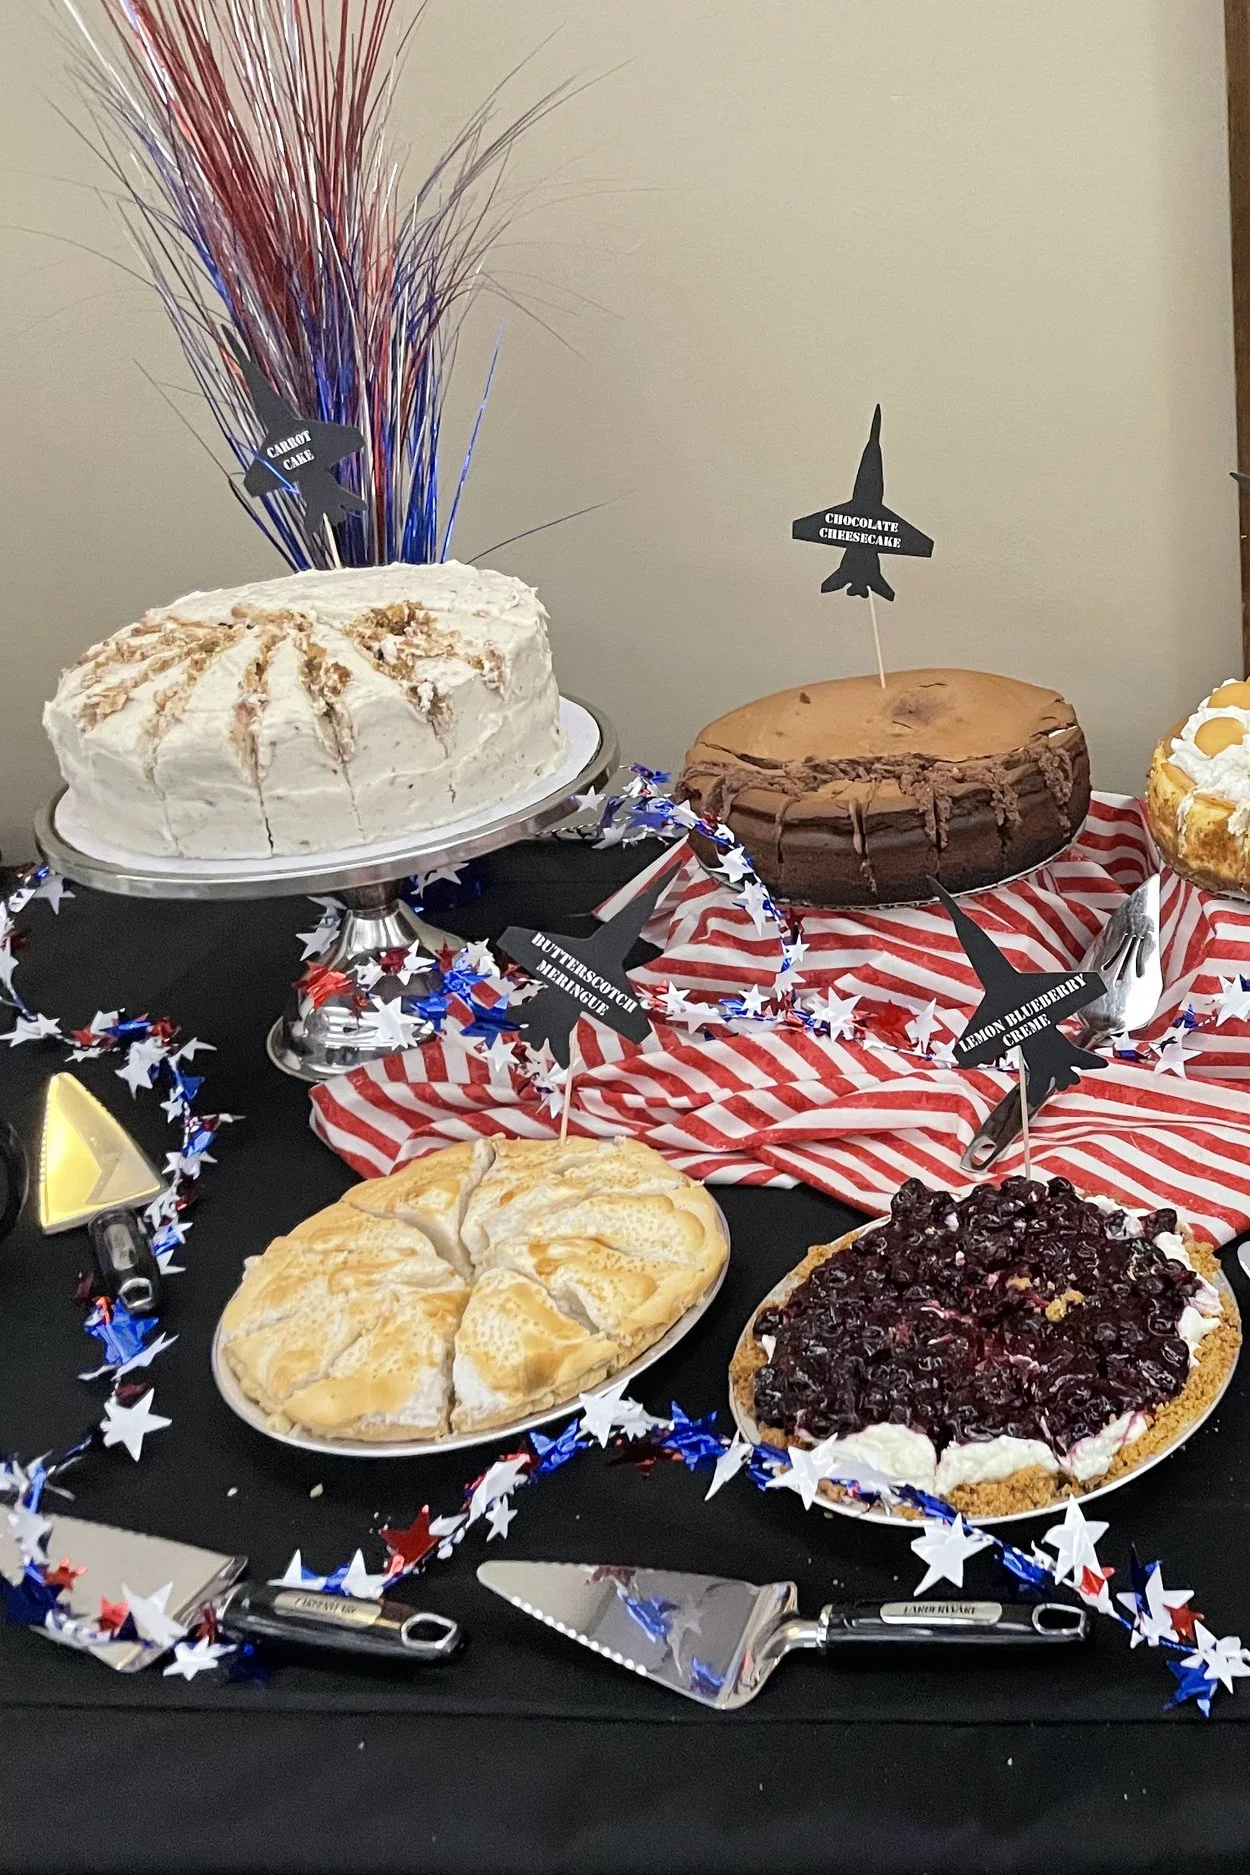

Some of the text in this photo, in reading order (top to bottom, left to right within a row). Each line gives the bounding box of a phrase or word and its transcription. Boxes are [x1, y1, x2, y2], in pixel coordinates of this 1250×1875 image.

[266, 429, 312, 458] CARROT
[283, 449, 315, 471] CAKE
[819, 527, 902, 548] CHEESECAKE
[824, 512, 899, 532] CHOCOLATE
[531, 932, 638, 1014] BUTTERSCOTCH
[536, 959, 609, 1016] MERINGUE
[958, 973, 1088, 1053] LEMON BLUEBERRY
[1002, 1013, 1051, 1047] CREME
